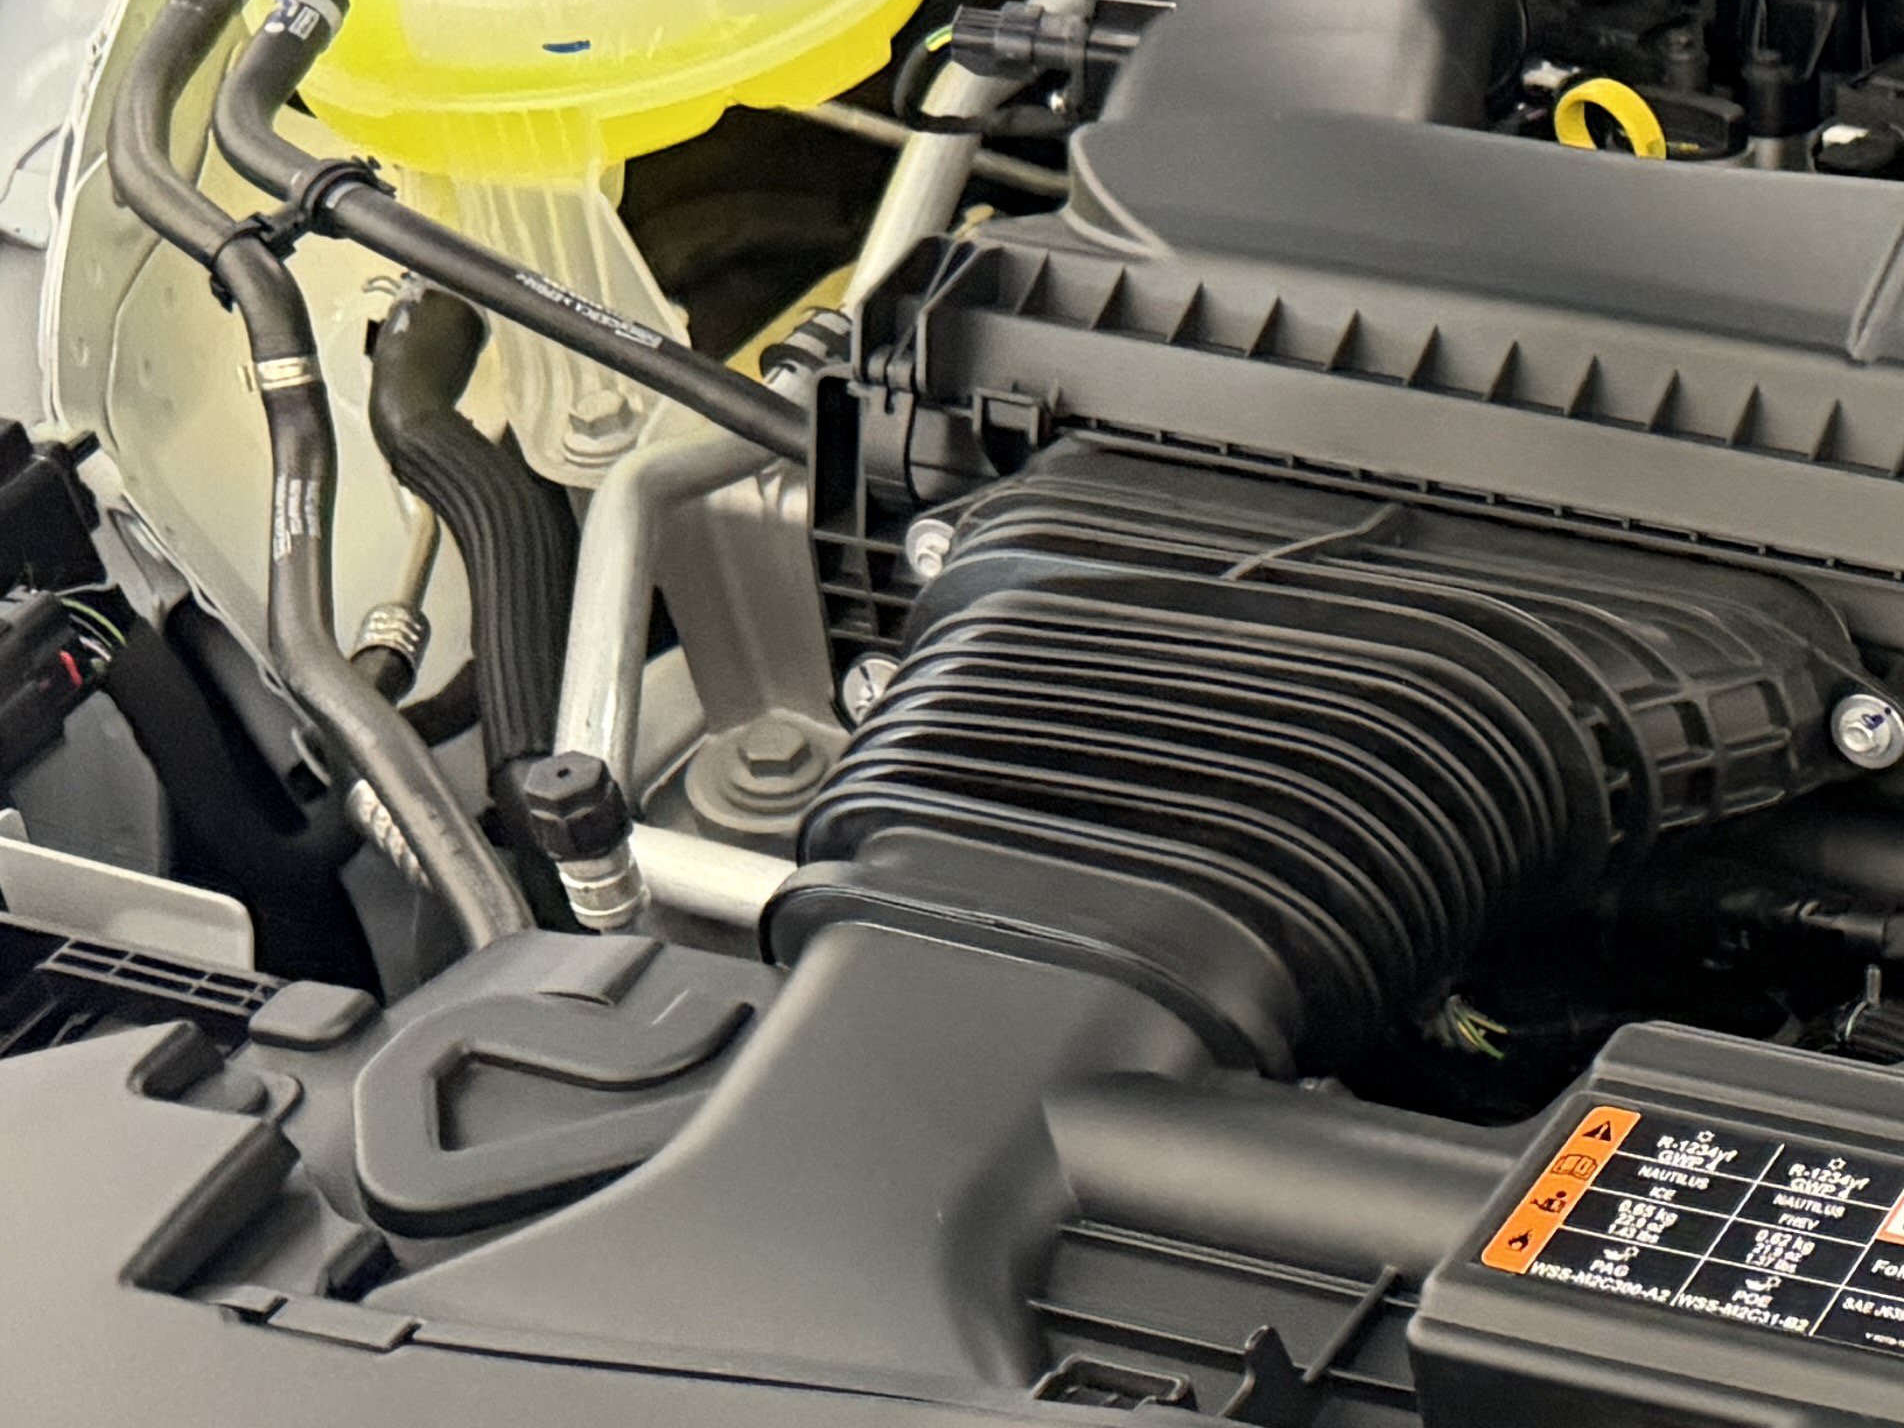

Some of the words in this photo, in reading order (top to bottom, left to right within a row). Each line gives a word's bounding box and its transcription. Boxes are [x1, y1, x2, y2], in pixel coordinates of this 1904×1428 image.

[1656, 1135, 1738, 1165] R-1234yf
[1637, 1165, 1711, 1190] NAUTILUS
[1788, 1163, 1870, 1191] R-1234yf
[1649, 1186, 1677, 1201] ICE
[1773, 1193, 1846, 1219] NAUTILUS
[1617, 1199, 1656, 1219] 0.65
[1655, 1207, 1679, 1228] kg
[1755, 1229, 1793, 1248] 0.62
[1792, 1236, 1816, 1256] kg
[1589, 1259, 1630, 1277] PAG
[1731, 1289, 1774, 1309] POE
